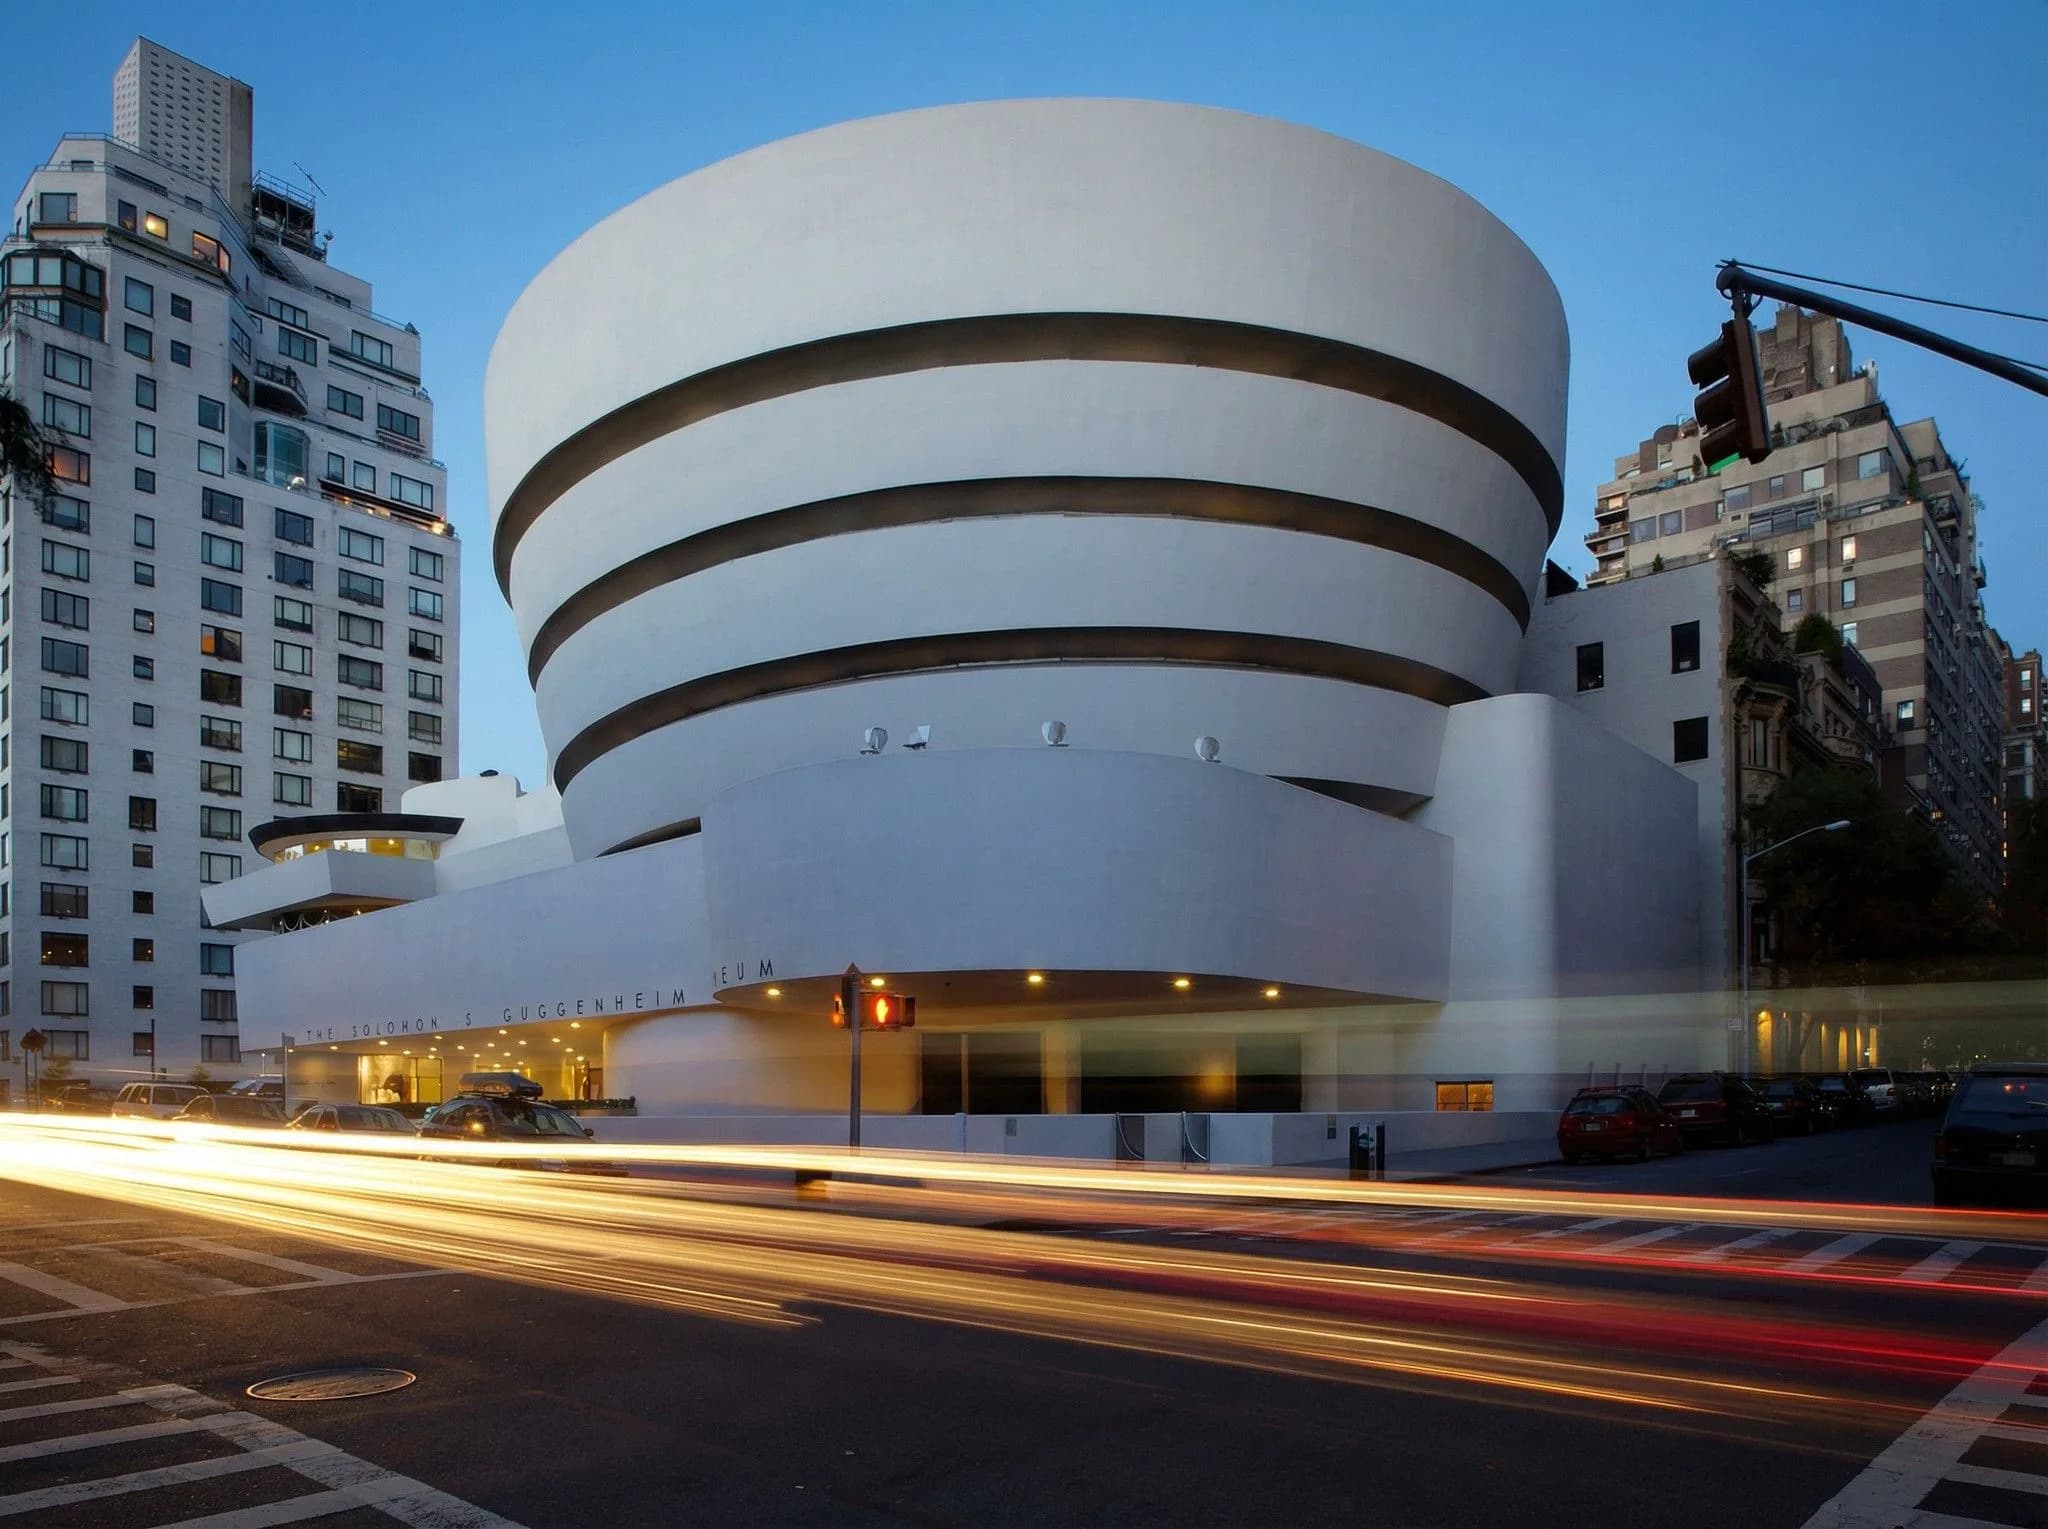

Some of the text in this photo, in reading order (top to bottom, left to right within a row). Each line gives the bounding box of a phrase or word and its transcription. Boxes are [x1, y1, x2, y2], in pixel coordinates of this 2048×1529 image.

[713, 959, 774, 987] EUM
[307, 1028, 333, 1041] THE
[503, 988, 686, 1022] GUGGENHEIM
